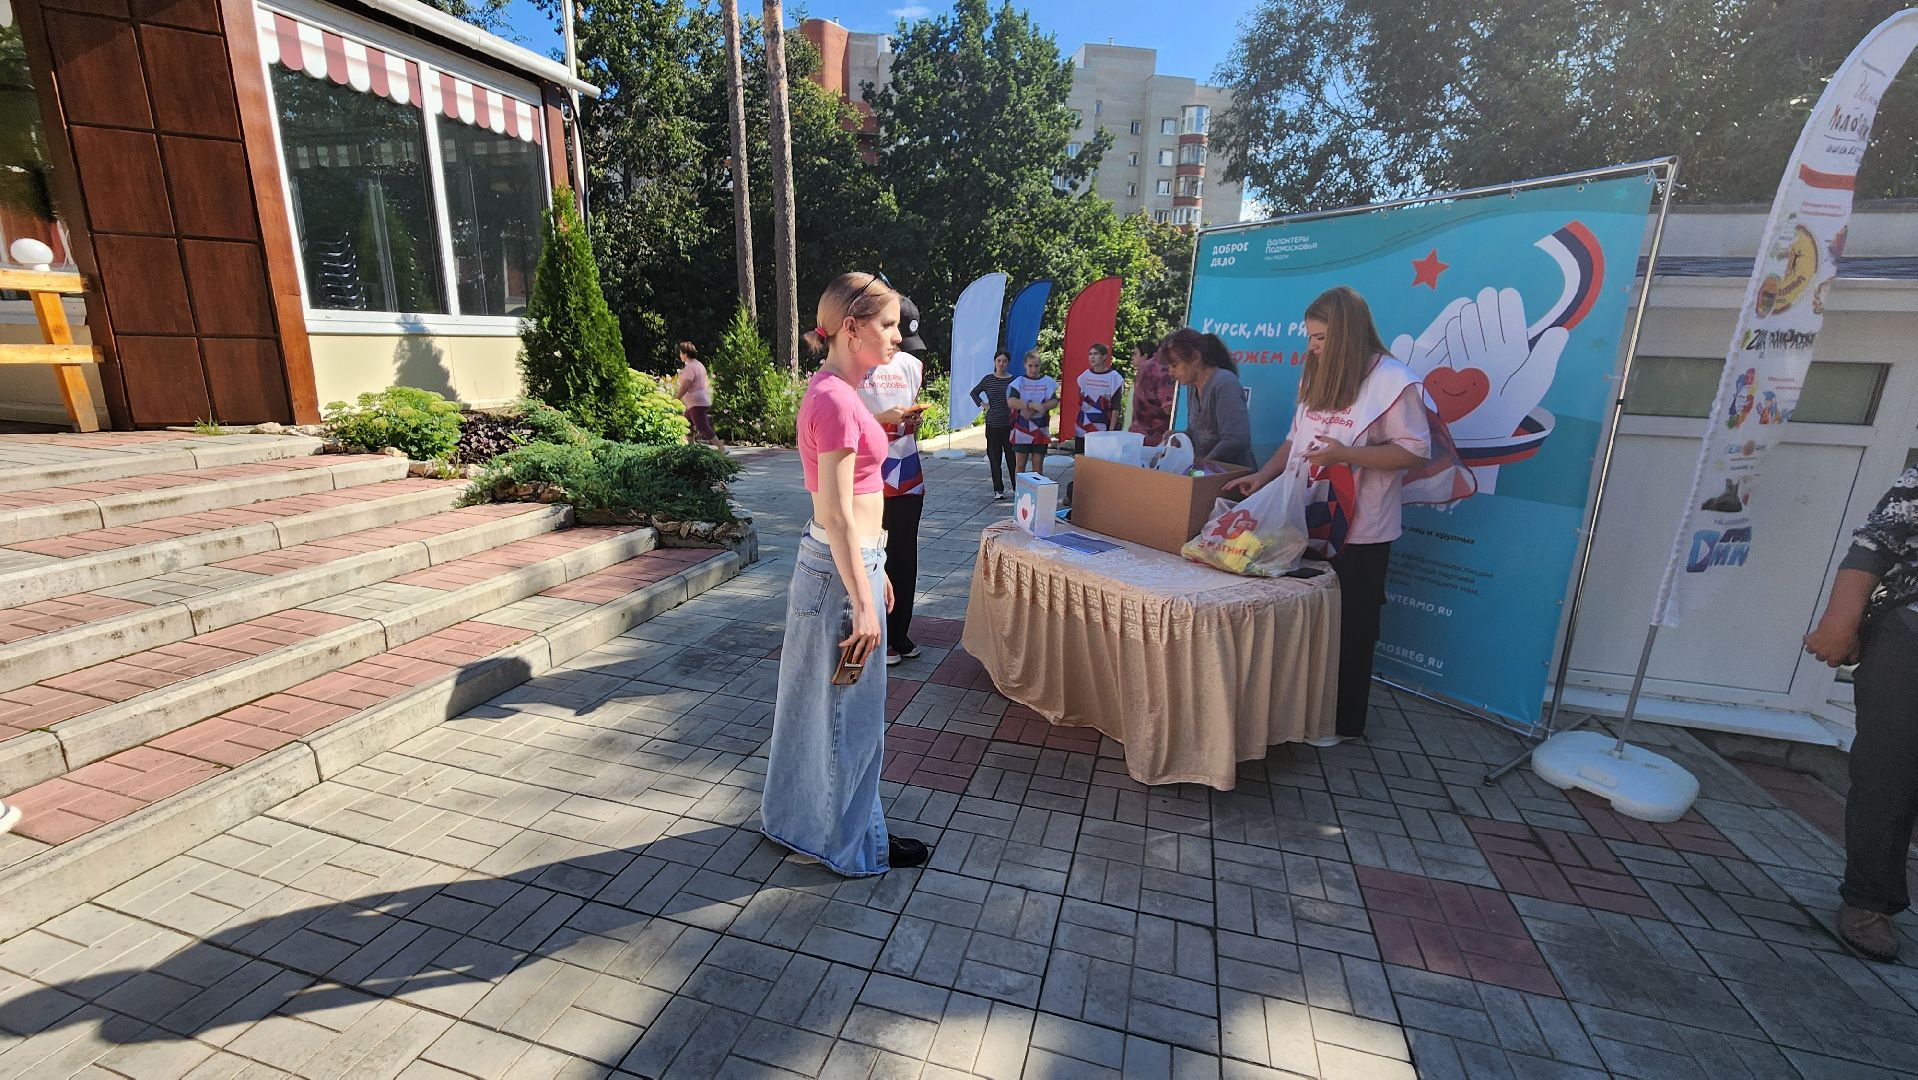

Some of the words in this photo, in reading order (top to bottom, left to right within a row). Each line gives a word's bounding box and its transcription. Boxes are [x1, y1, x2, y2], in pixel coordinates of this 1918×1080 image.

[1212, 242, 1249, 256] ДОБРОЕ
[1265, 243, 1318, 254] ПОДМОСКОВЬЯ
[1210, 256, 1236, 268] ДЕЛО
[1287, 321, 1310, 338] РЯ
[1231, 350, 1284, 365] ОЖЕМ
